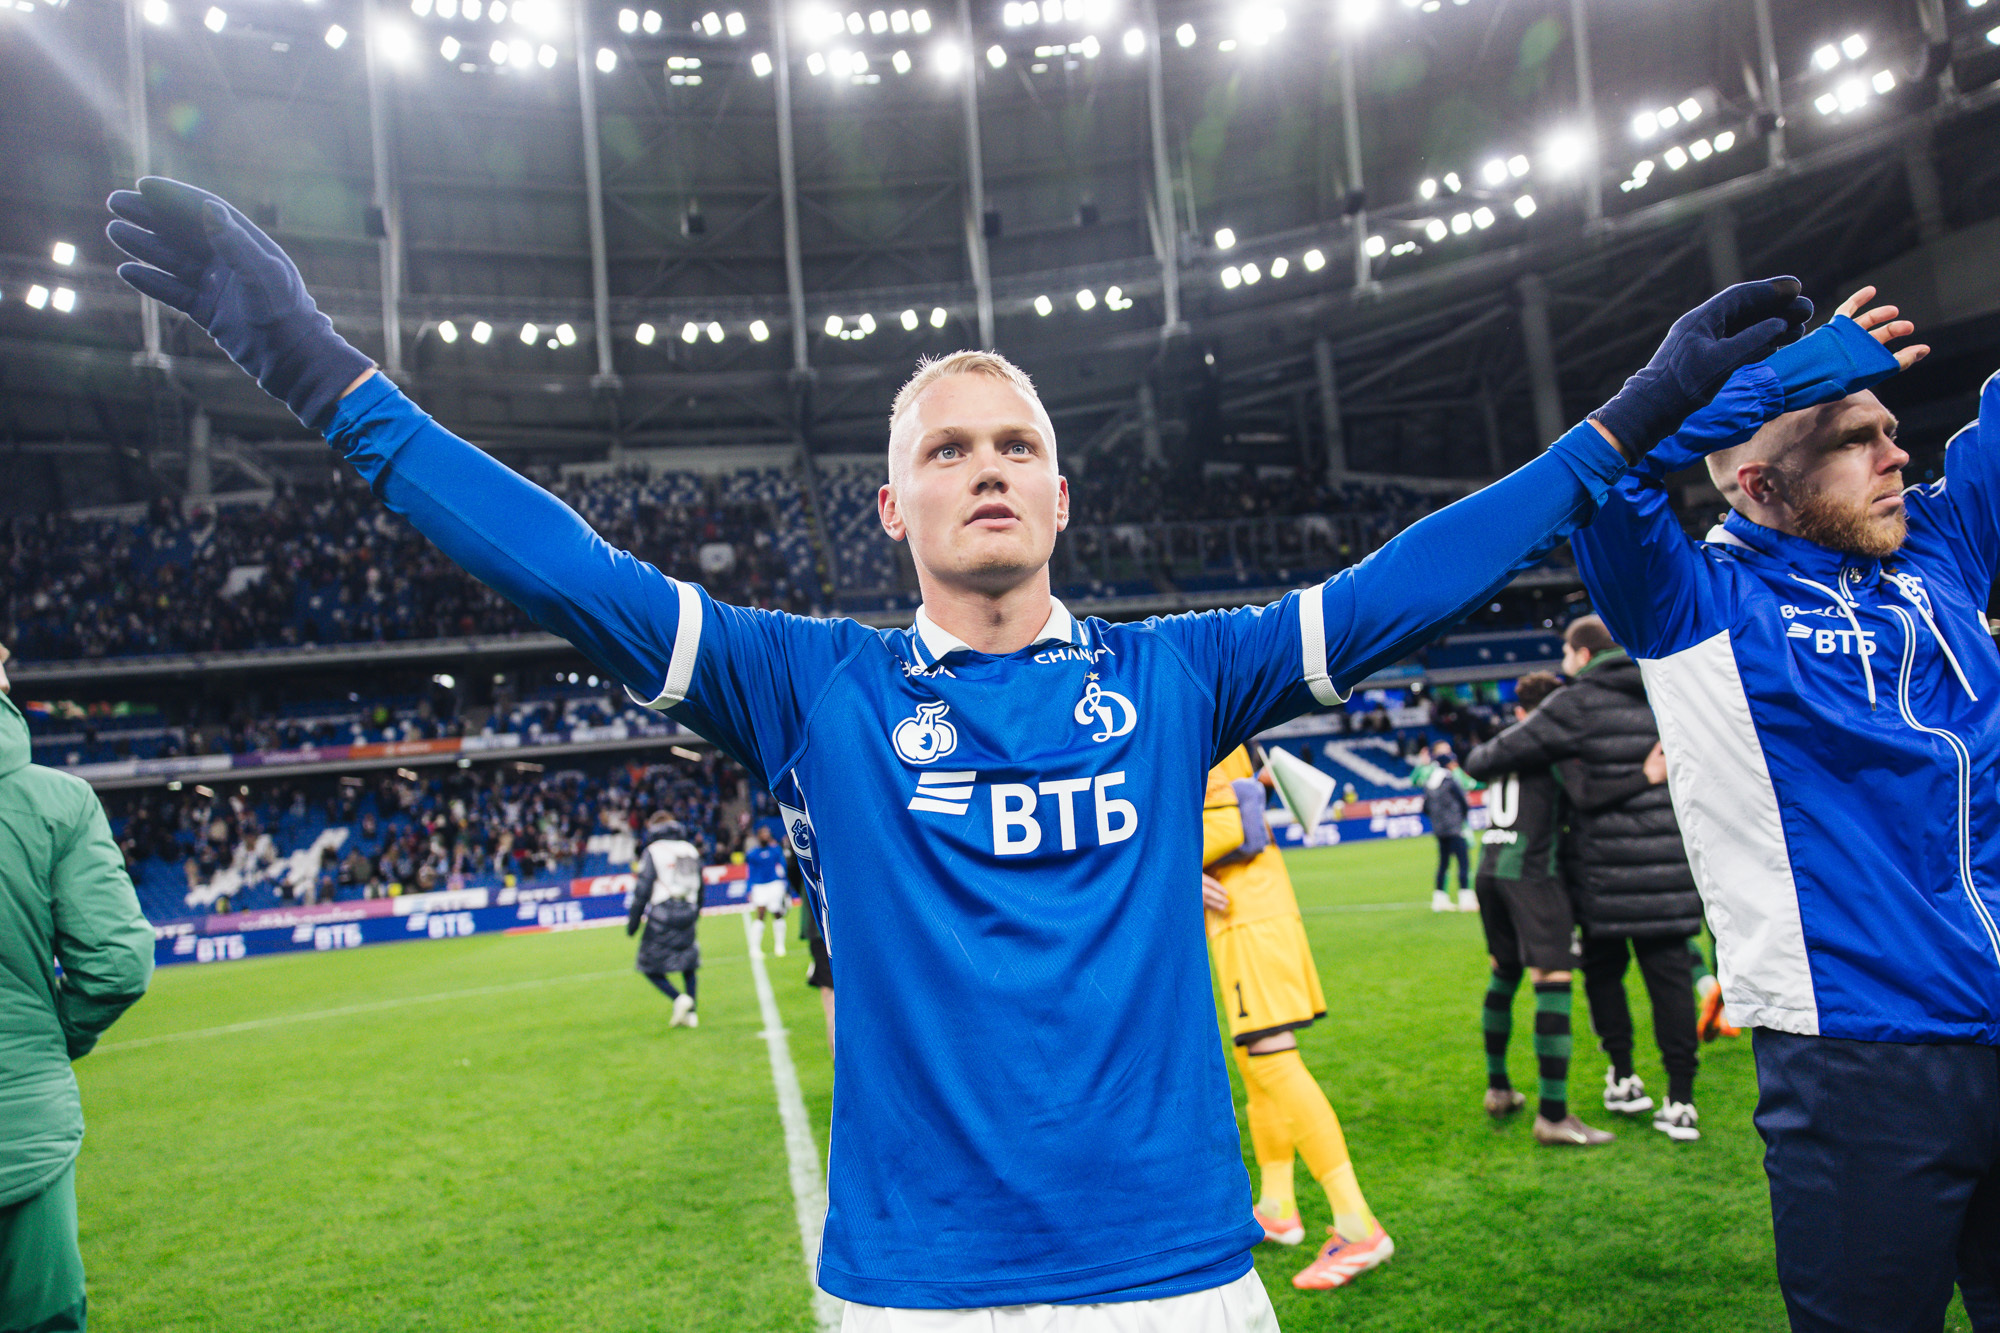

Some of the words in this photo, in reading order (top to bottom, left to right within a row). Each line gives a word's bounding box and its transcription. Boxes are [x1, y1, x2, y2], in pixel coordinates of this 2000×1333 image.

[1816, 629, 1877, 656] ВТБ
[991, 771, 1138, 855] ВТБ
[1236, 982, 1248, 1017] 1
